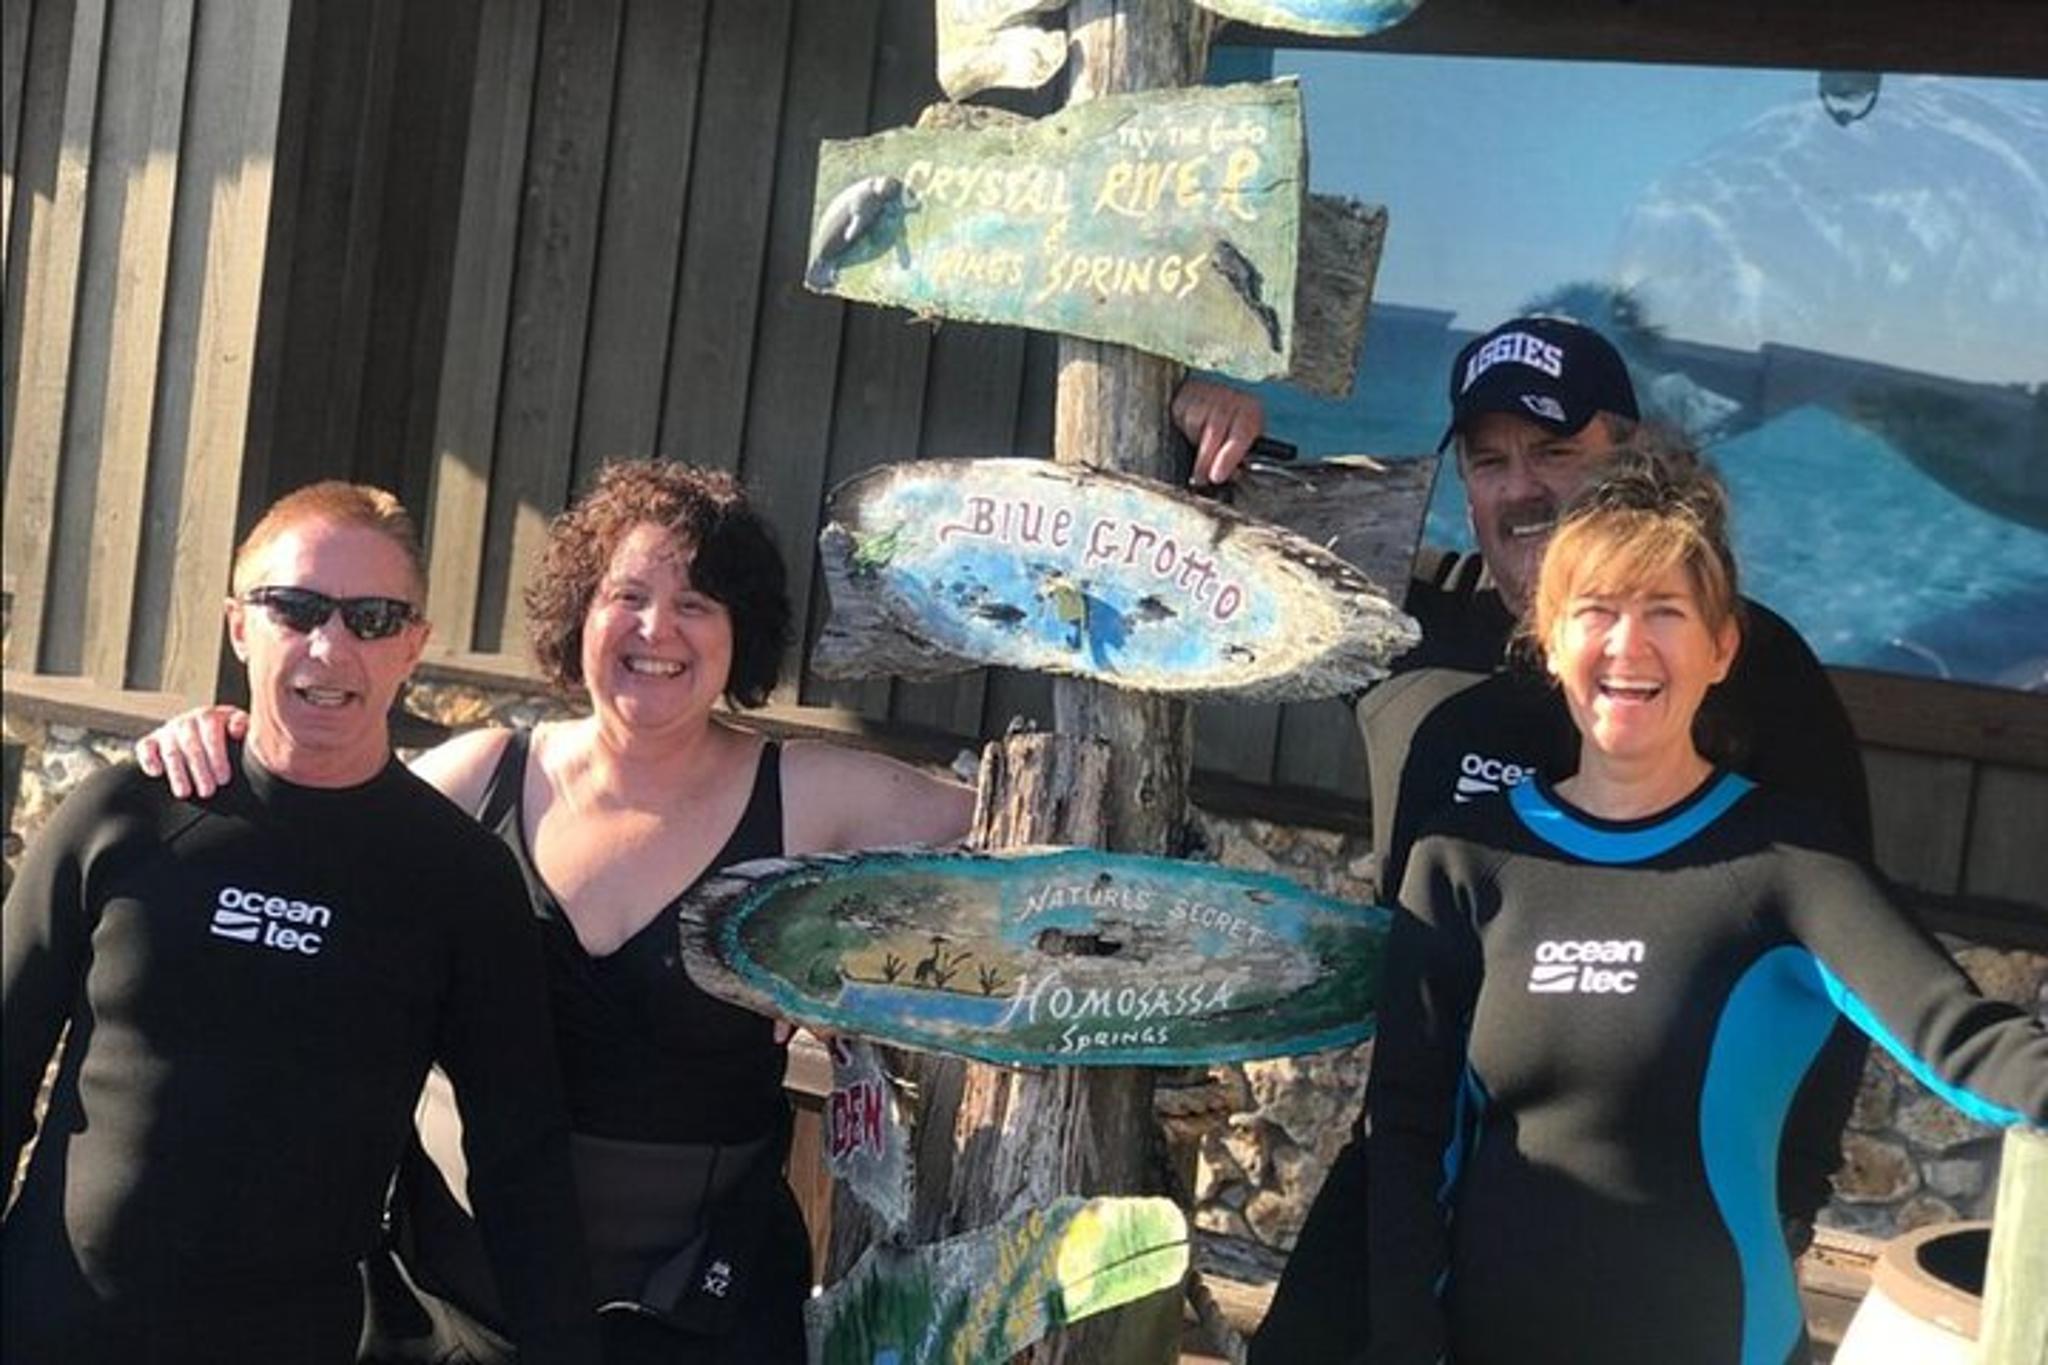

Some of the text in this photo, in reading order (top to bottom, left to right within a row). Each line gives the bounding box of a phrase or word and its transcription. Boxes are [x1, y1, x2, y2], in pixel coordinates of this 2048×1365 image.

[904, 147, 1262, 222] CRYSTAL RIVER
[1034, 252, 1207, 304] SPRINGS
[1460, 331, 1564, 394] AGGIES
[1461, 753, 1536, 786] oce
[217, 886, 331, 928] ocean
[1168, 897, 1266, 946] SECRET
[264, 920, 323, 954] tec
[1534, 940, 1646, 963] ocean
[1000, 971, 1234, 1027] HOMOSASSA
[1578, 966, 1639, 994] tec
[829, 1080, 885, 1162] DEN
